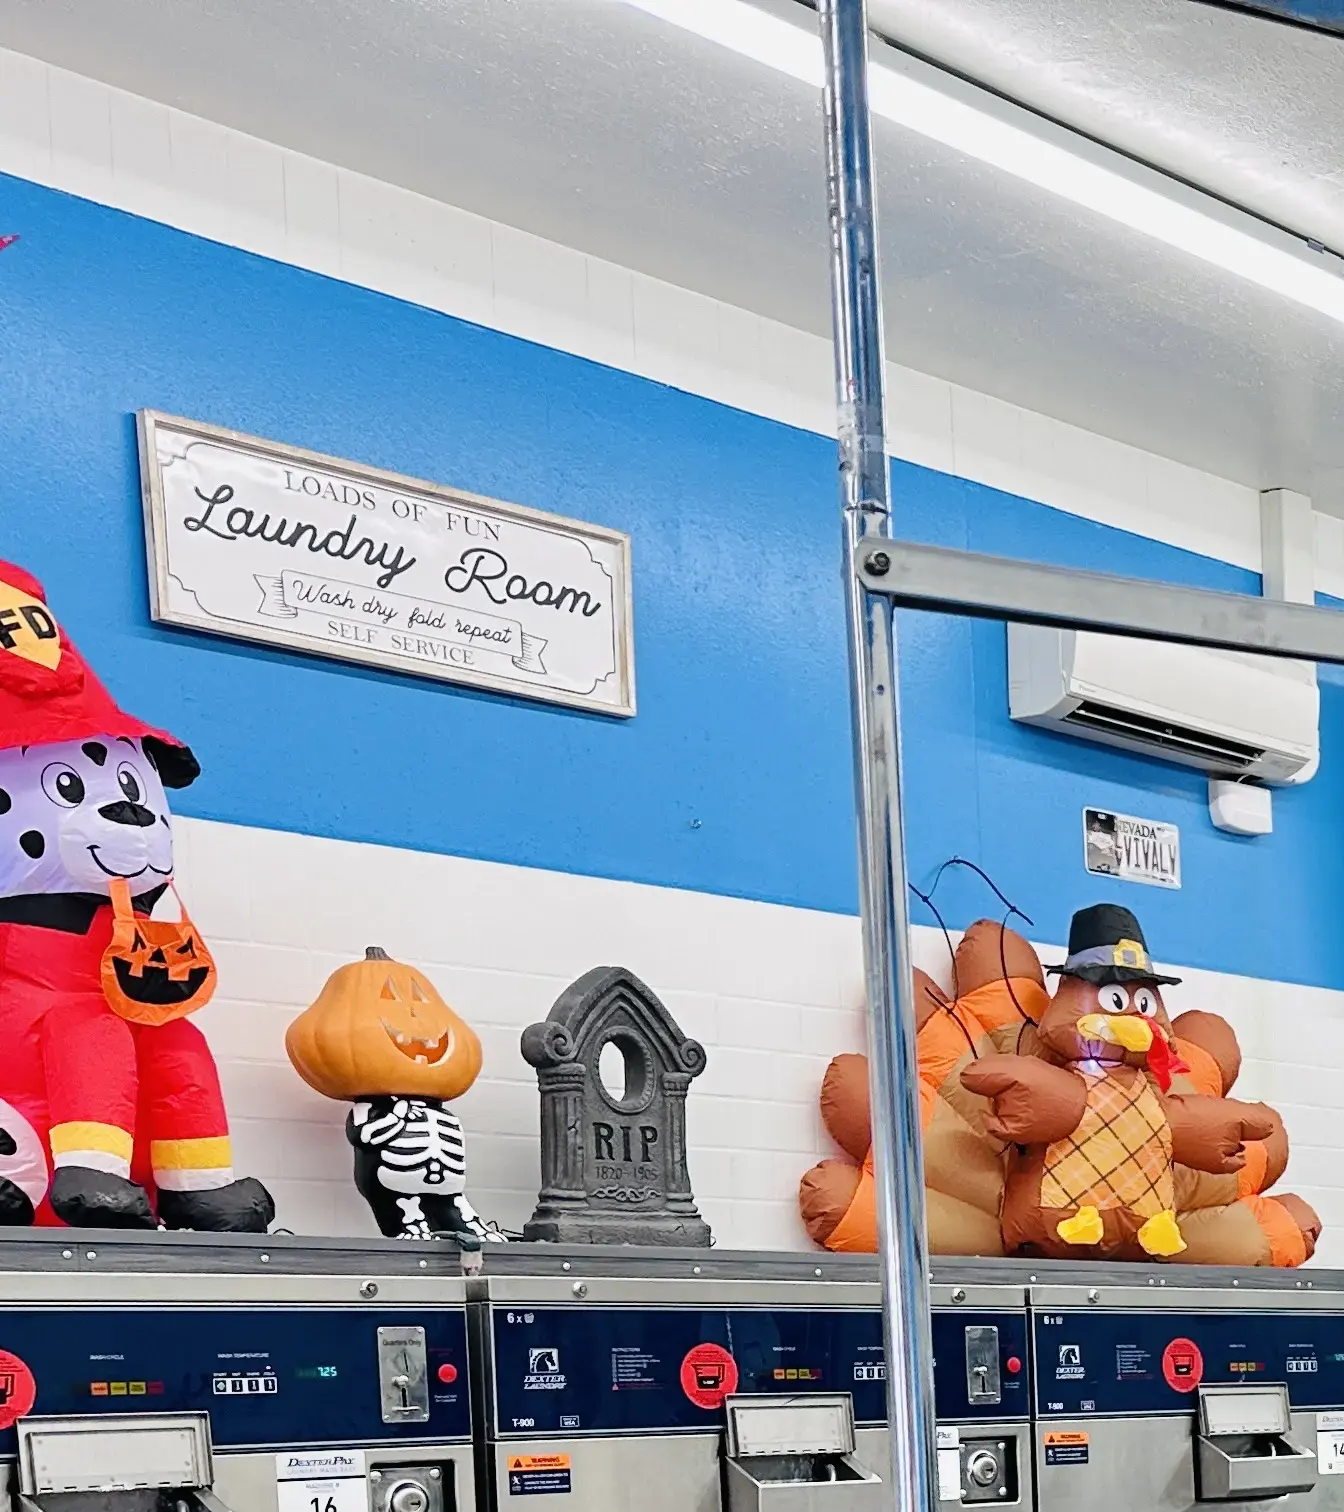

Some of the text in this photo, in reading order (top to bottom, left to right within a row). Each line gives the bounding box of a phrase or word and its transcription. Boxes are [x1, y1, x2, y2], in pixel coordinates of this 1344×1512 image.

[284, 470, 501, 541] LOADS OF FUN
[183, 484, 602, 618] Laundry Room
[292, 579, 513, 646] Wash dry fold repeat
[328, 620, 475, 666] SELF SERVICE
[592, 1121, 658, 1163] RIP
[507, 1313, 515, 1323] 6
[409, 1339, 422, 1347] Only
[524, 1374, 566, 1383] DEXTER
[512, 1418, 535, 1427] T-900
